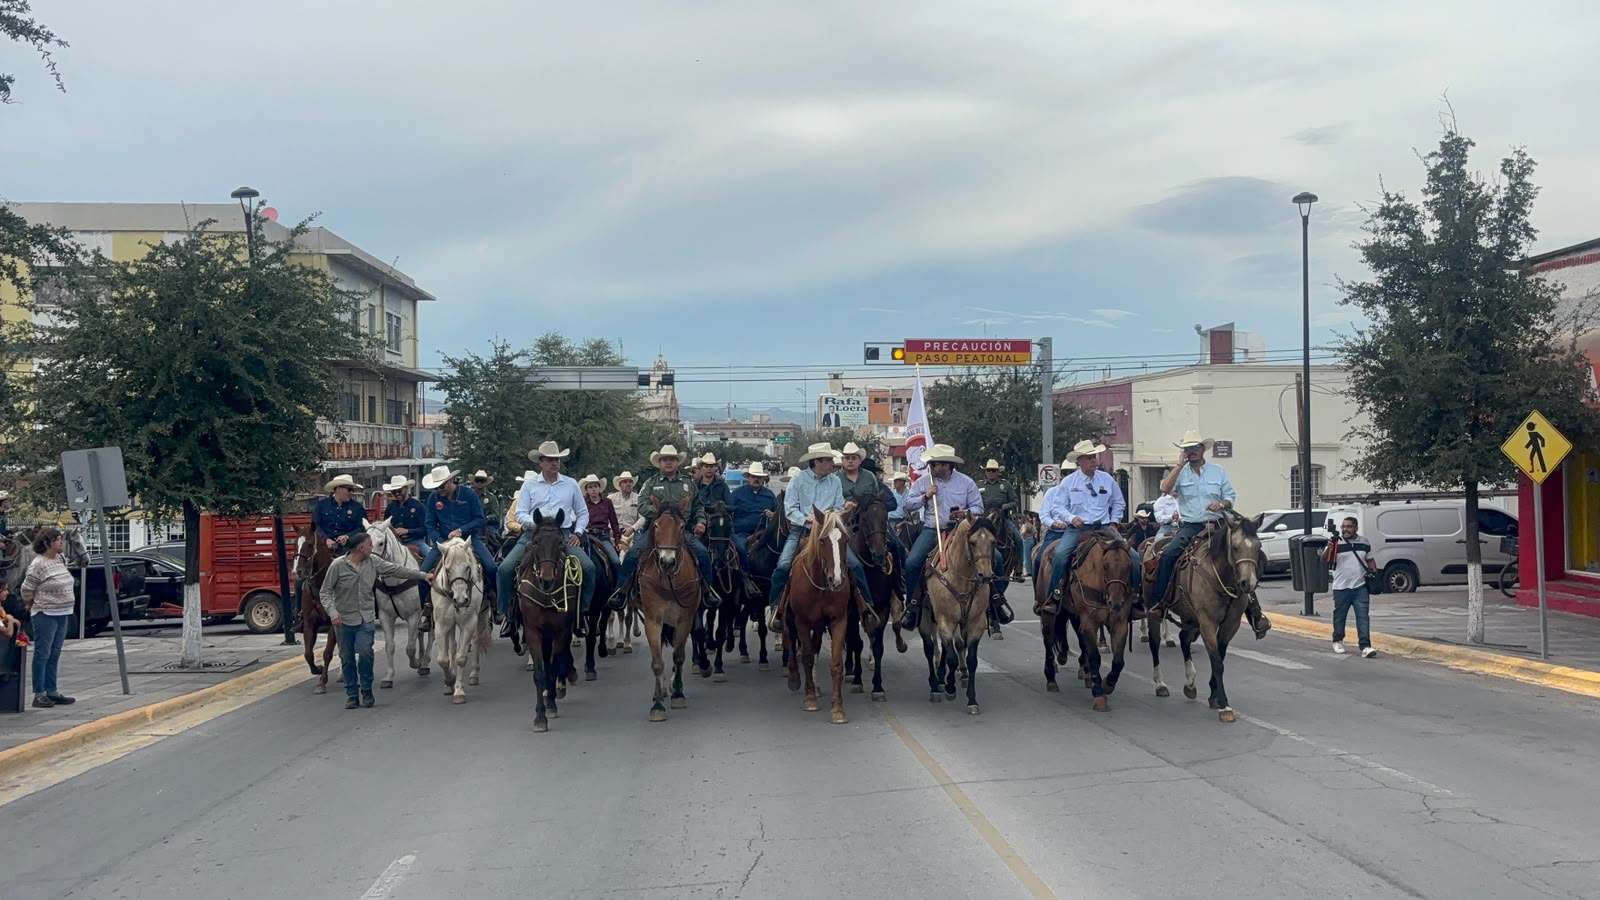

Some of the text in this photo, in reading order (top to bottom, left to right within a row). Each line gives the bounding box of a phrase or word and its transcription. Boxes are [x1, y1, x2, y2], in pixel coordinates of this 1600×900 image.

[924, 341, 1012, 351] PRECAUCIÓN
[916, 354, 1020, 363] PASO PEATONAL
[824, 397, 861, 405] Rafa
